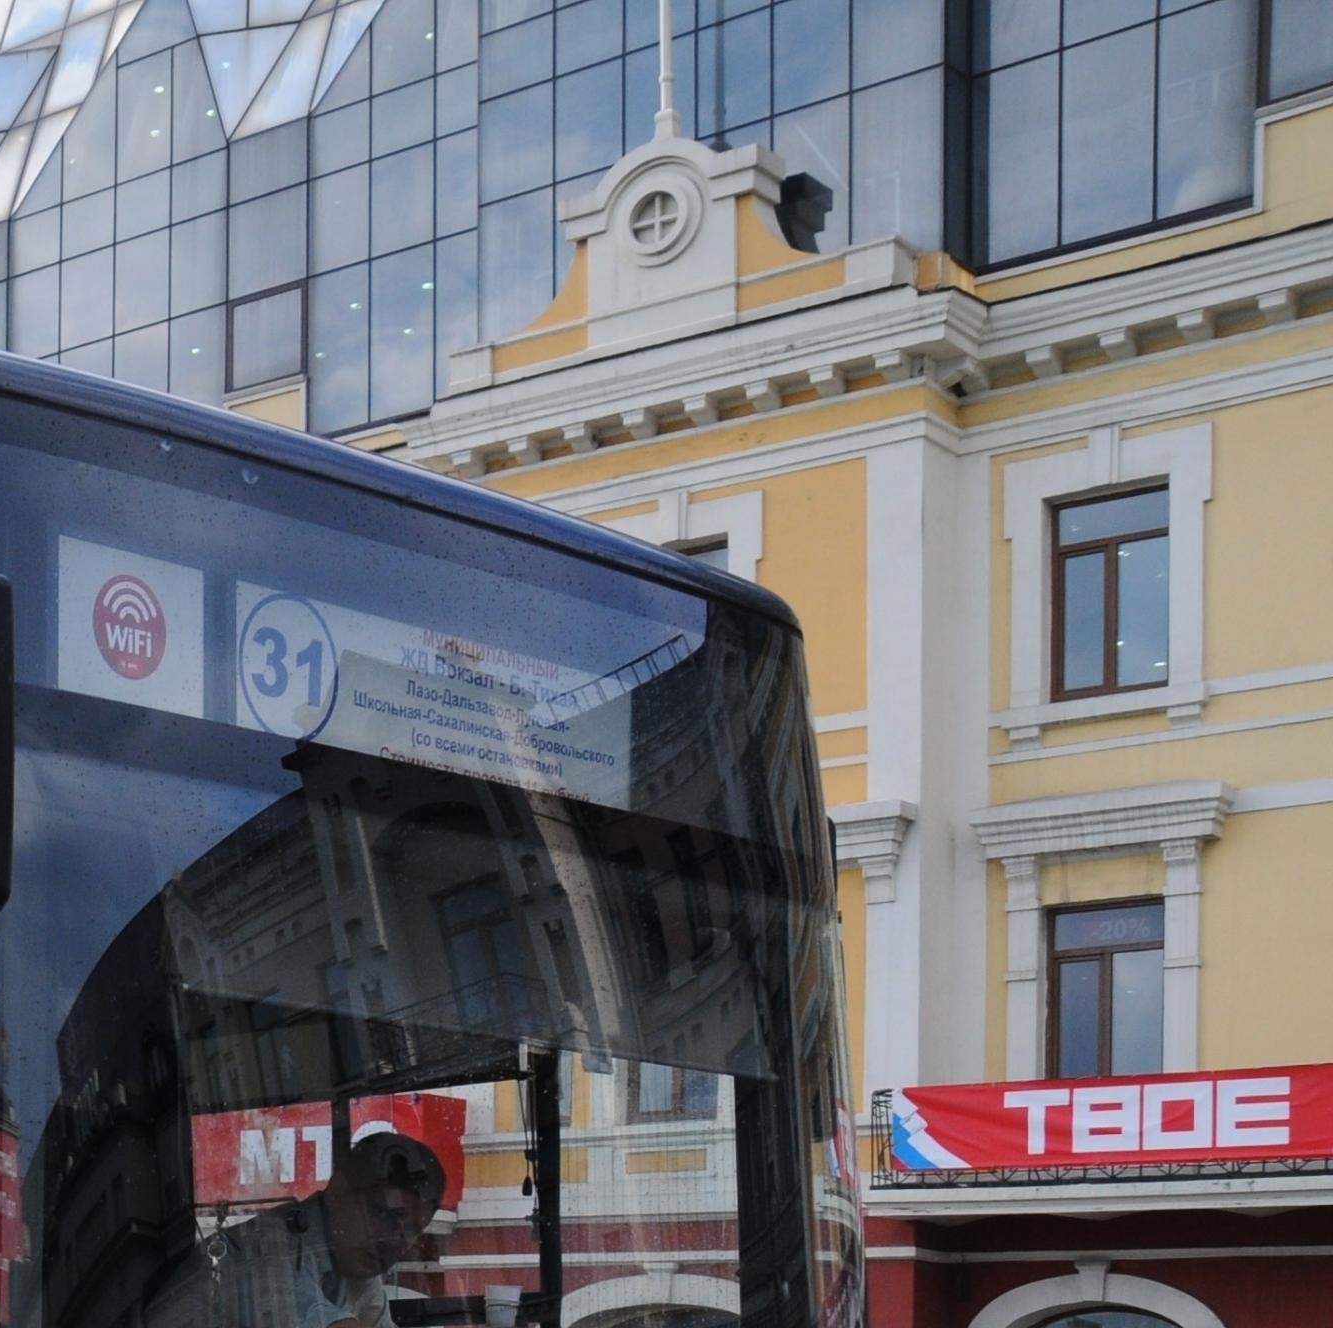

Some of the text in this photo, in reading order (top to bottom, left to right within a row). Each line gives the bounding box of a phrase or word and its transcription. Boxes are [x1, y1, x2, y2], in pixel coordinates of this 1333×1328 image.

[104, 622, 153, 658] WiFi
[422, 630, 560, 680] МУНИЦИПАЛЬНЫЙ
[251, 624, 326, 708] 31
[400, 646, 429, 676] ЖД
[434, 650, 495, 689] Вокзал
[1004, 1076, 1291, 1155] ТВОЕ
